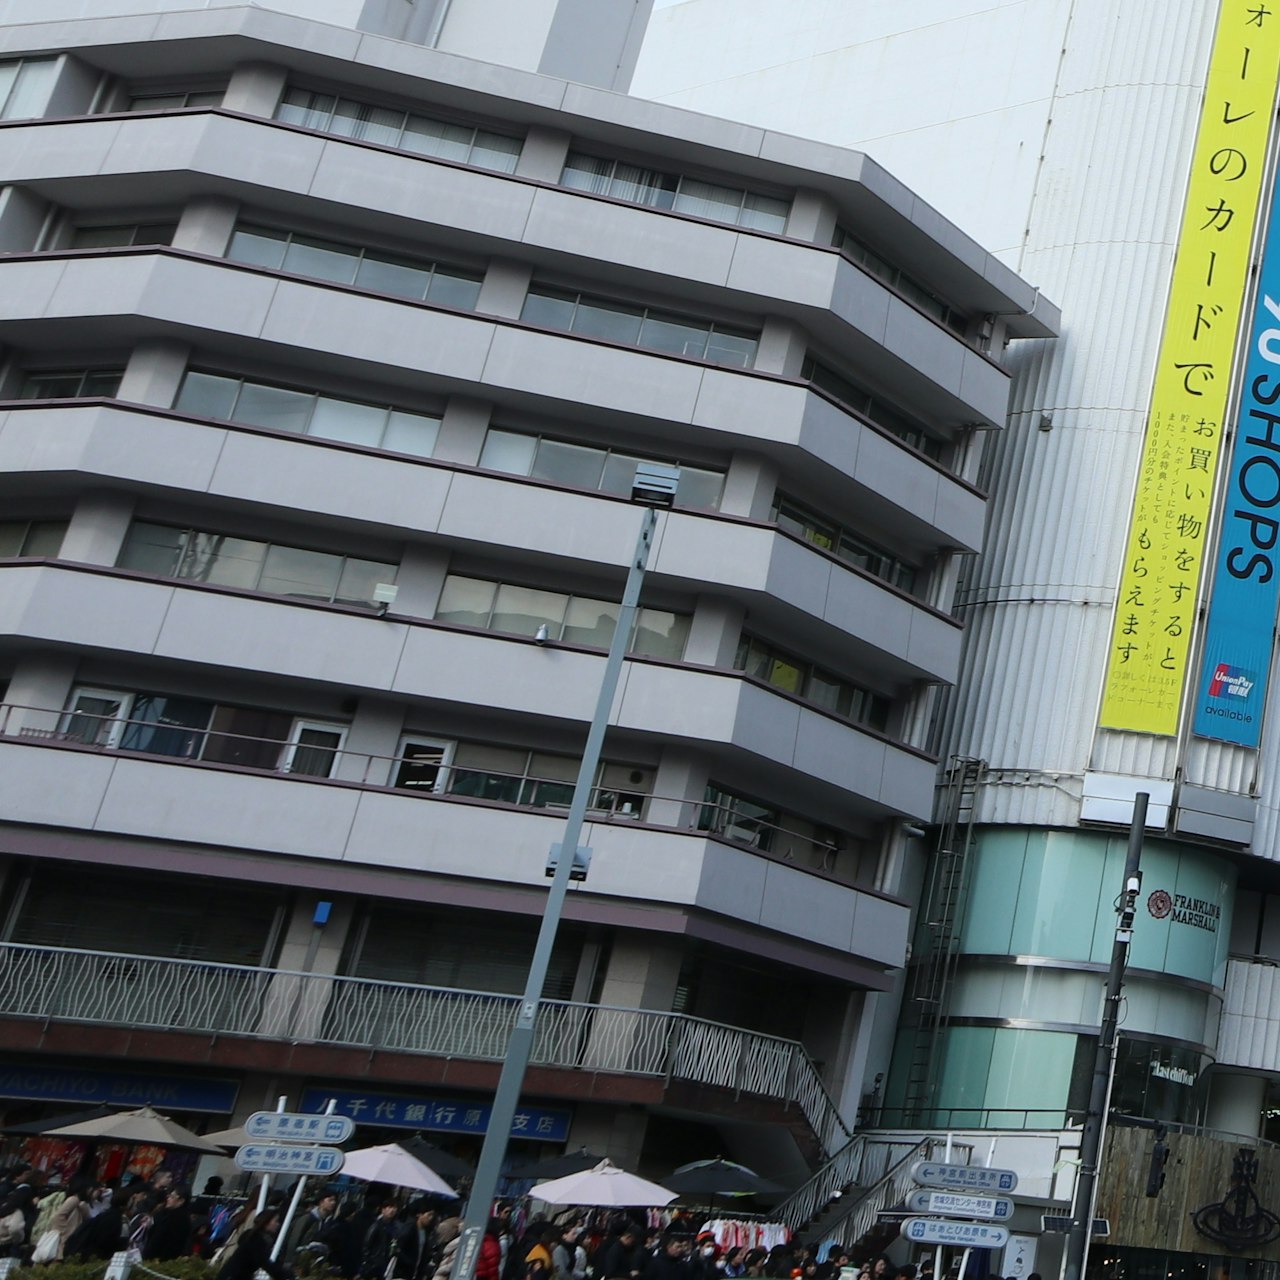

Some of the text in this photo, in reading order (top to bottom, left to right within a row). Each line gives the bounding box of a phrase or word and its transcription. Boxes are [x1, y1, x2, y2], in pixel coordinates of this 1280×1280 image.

[1160, 417, 1217, 670] お買い物をすると
[1117, 527, 1152, 664] もらえます
[1214, 670, 1254, 689] UnionPay
[1205, 706, 1253, 723] available
[1174, 894, 1216, 917] FRANKLIN
[1171, 908, 1217, 933] MARSHALL
[112, 1080, 180, 1101] BANK
[315, 1097, 556, 1135] 八千代銀行原支店
[938, 1167, 997, 1182] 神宮前出張所
